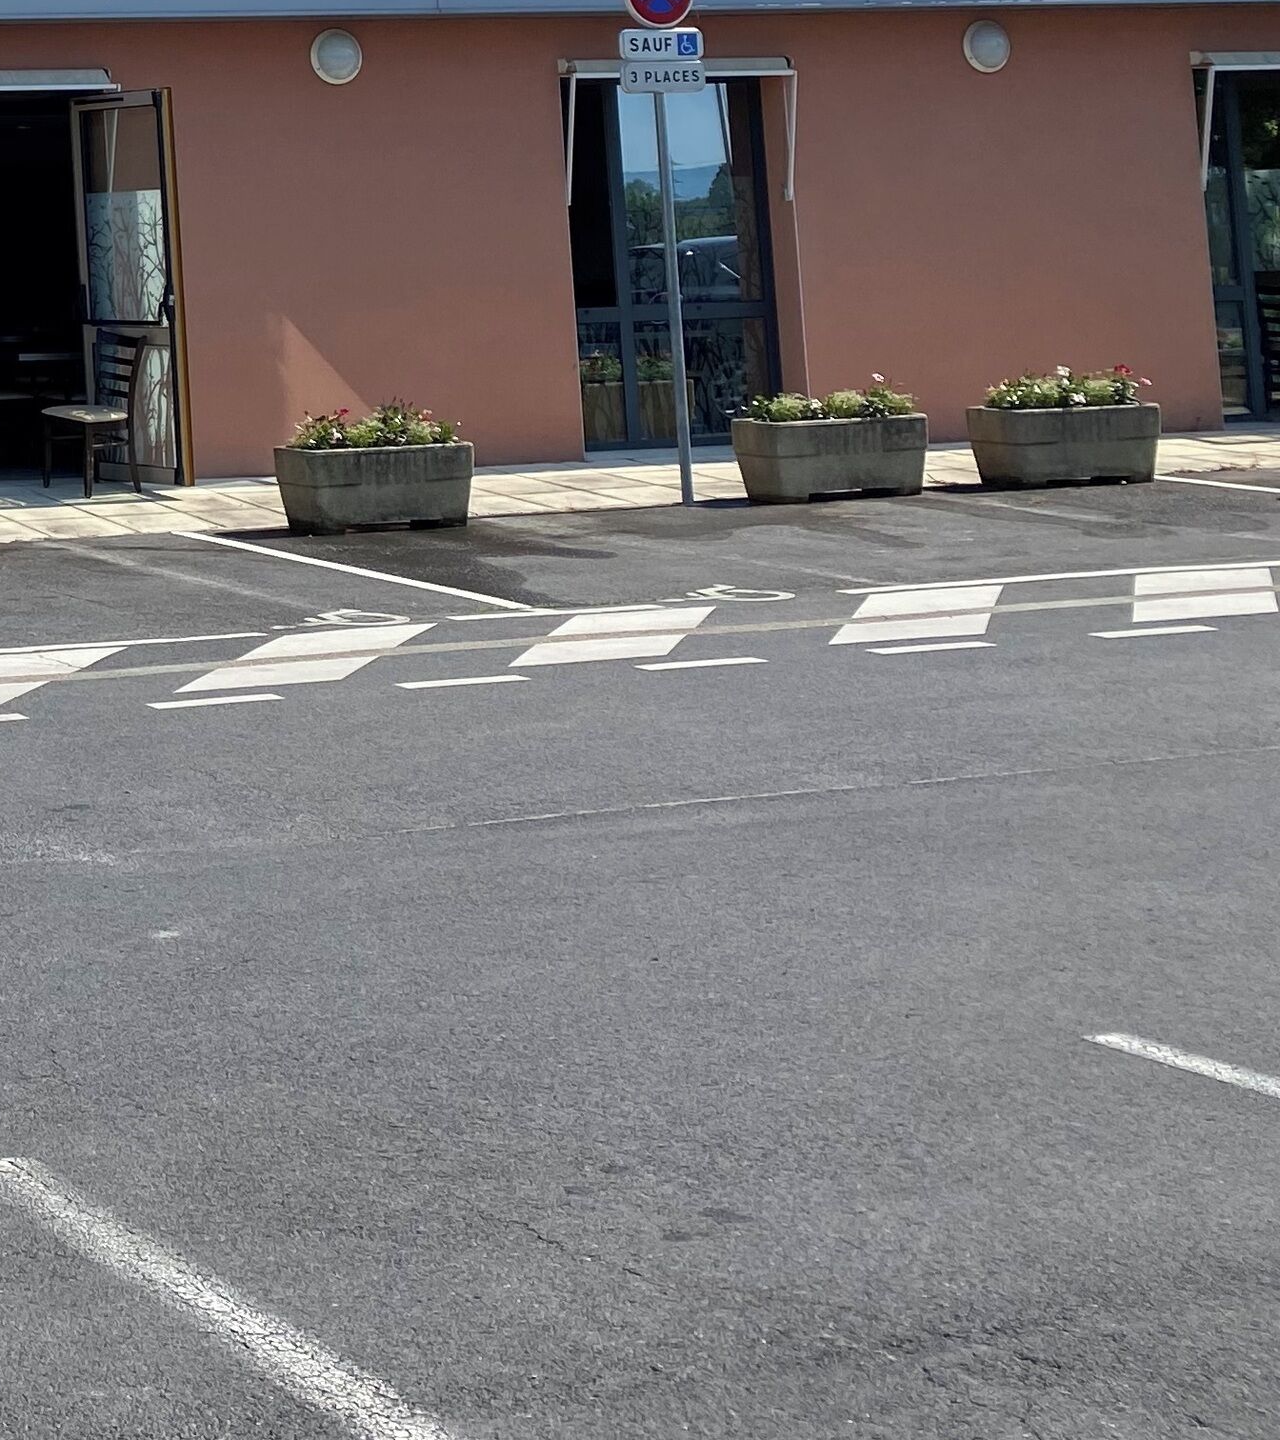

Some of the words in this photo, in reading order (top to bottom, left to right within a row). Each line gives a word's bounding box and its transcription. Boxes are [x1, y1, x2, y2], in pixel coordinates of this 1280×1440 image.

[630, 37, 672, 52] SAUF
[630, 71, 638, 83] 3
[644, 70, 700, 83] PLACES
